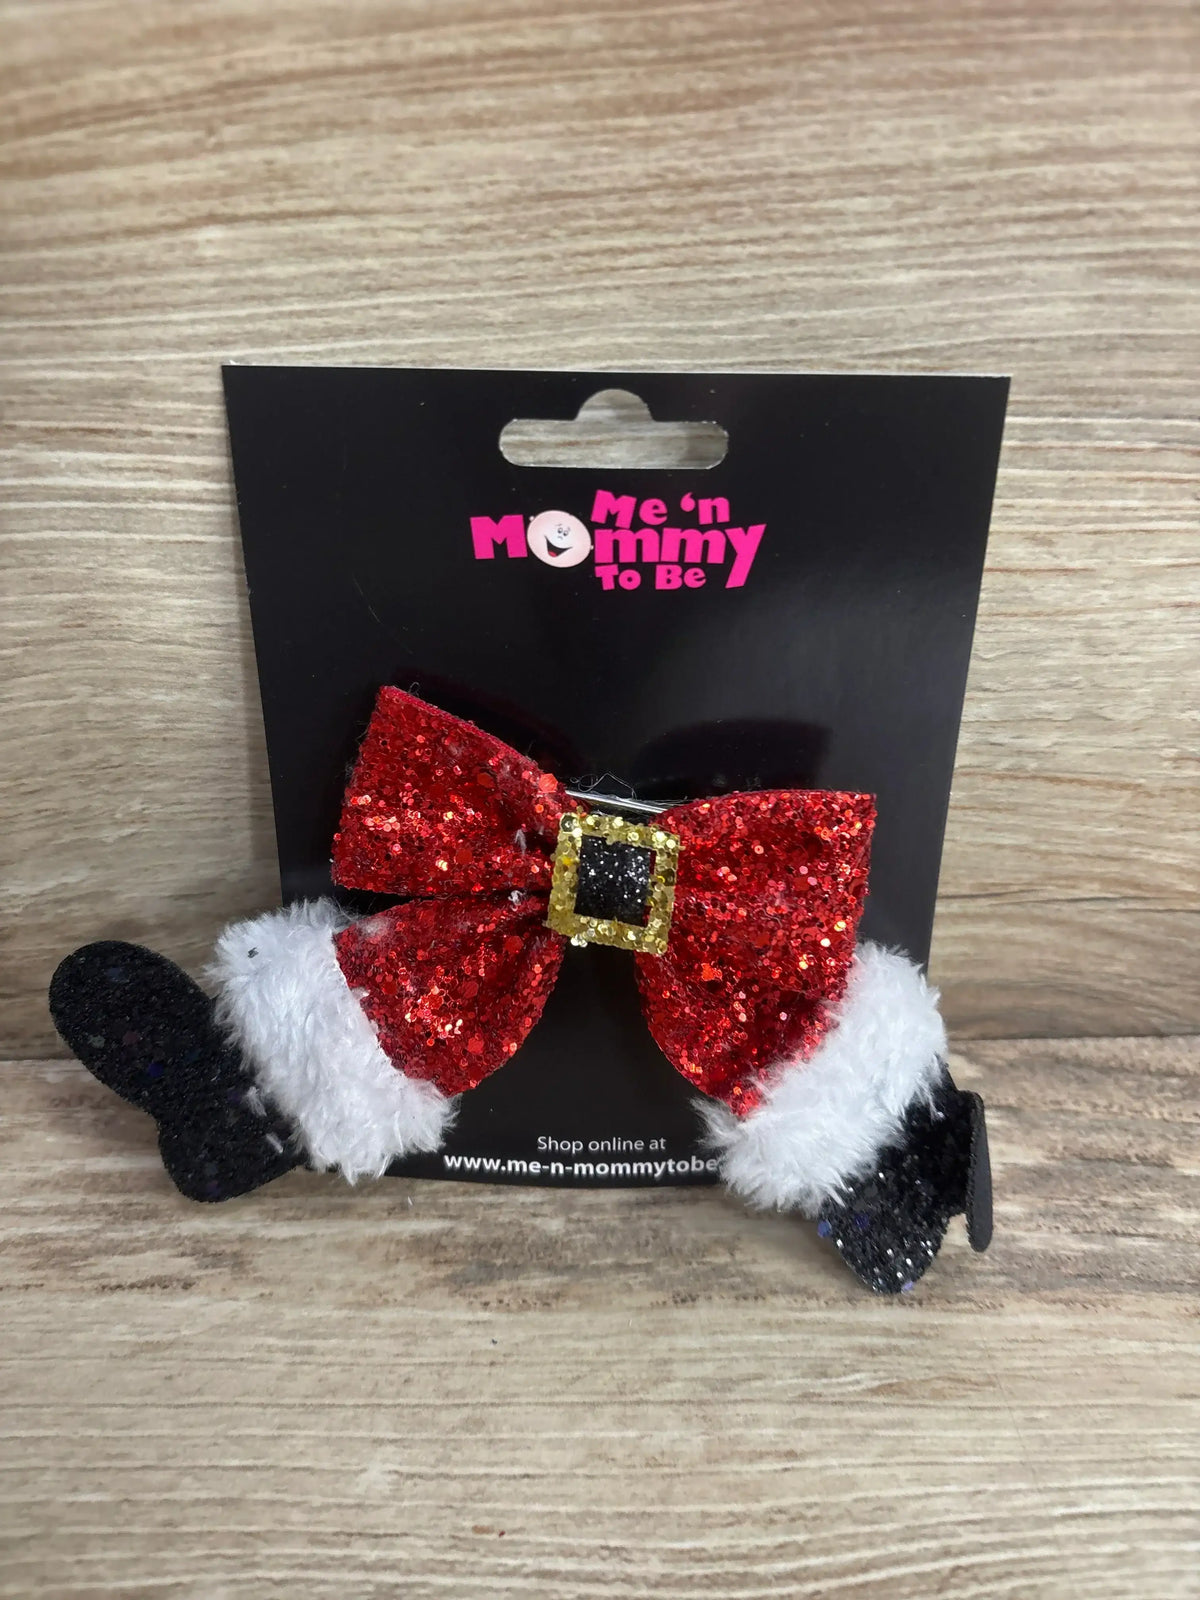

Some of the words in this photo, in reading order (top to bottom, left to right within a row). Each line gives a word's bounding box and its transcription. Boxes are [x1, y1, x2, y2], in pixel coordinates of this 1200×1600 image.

[590, 489, 668, 528] Me
[594, 564, 642, 591] To
[655, 564, 707, 590] Be
[537, 1135, 584, 1156] Shop
[588, 1136, 645, 1152] online
[649, 1137, 667, 1151] at
